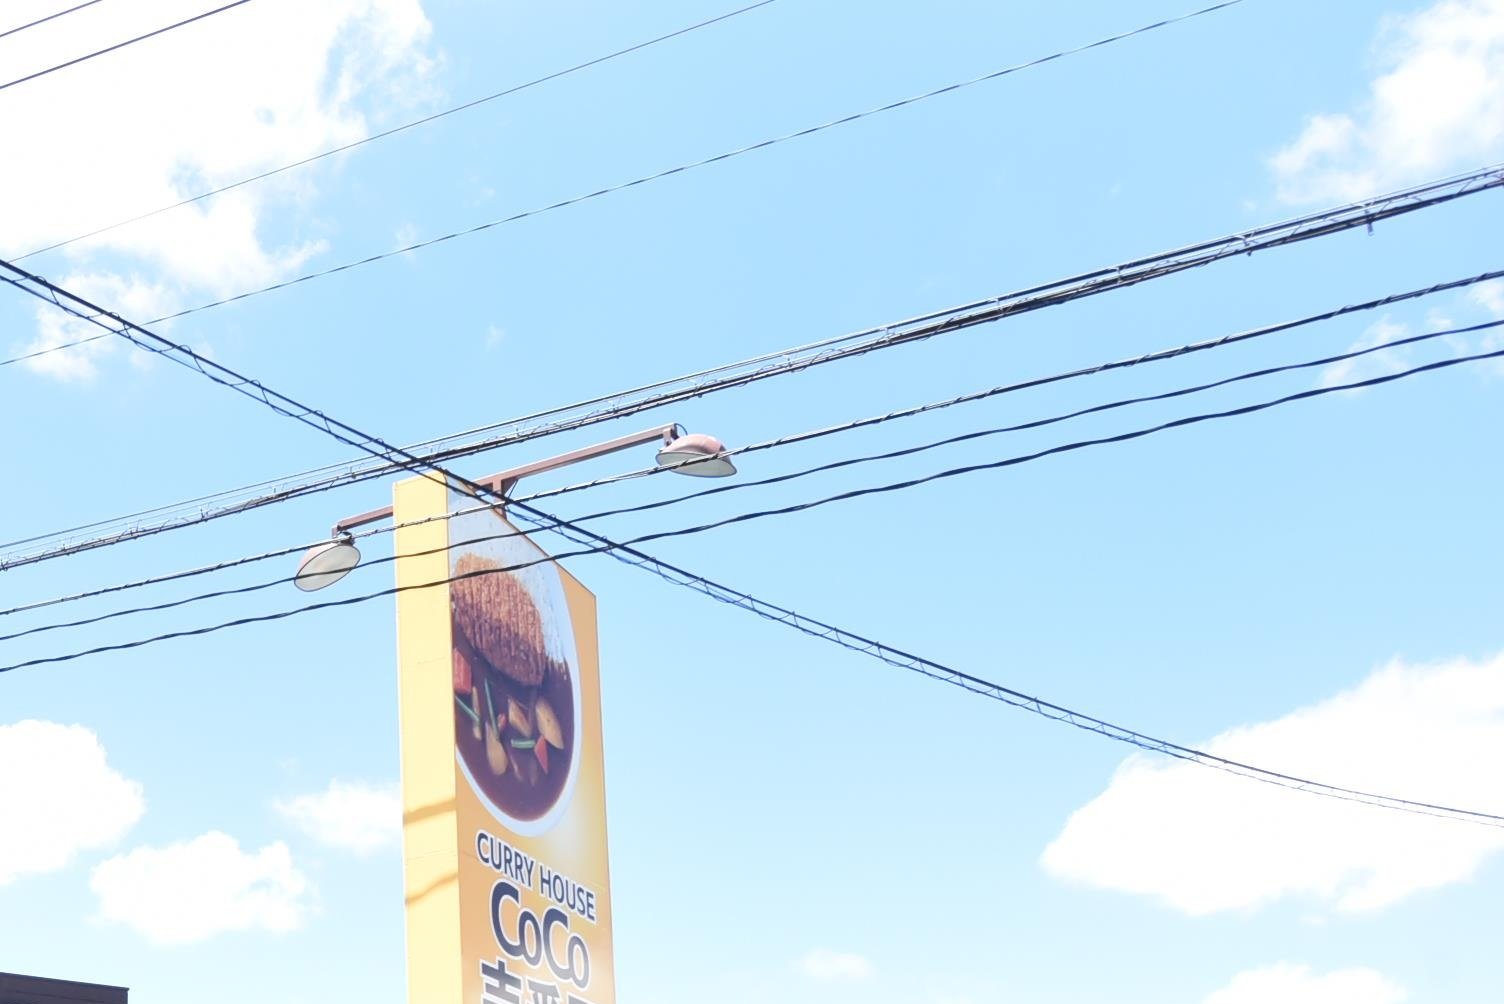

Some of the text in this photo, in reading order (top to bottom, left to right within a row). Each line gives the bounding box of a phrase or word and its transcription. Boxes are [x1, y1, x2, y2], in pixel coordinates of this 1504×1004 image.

[476, 832, 595, 922] CURRY HOUSE
[491, 881, 590, 990] CoCo
